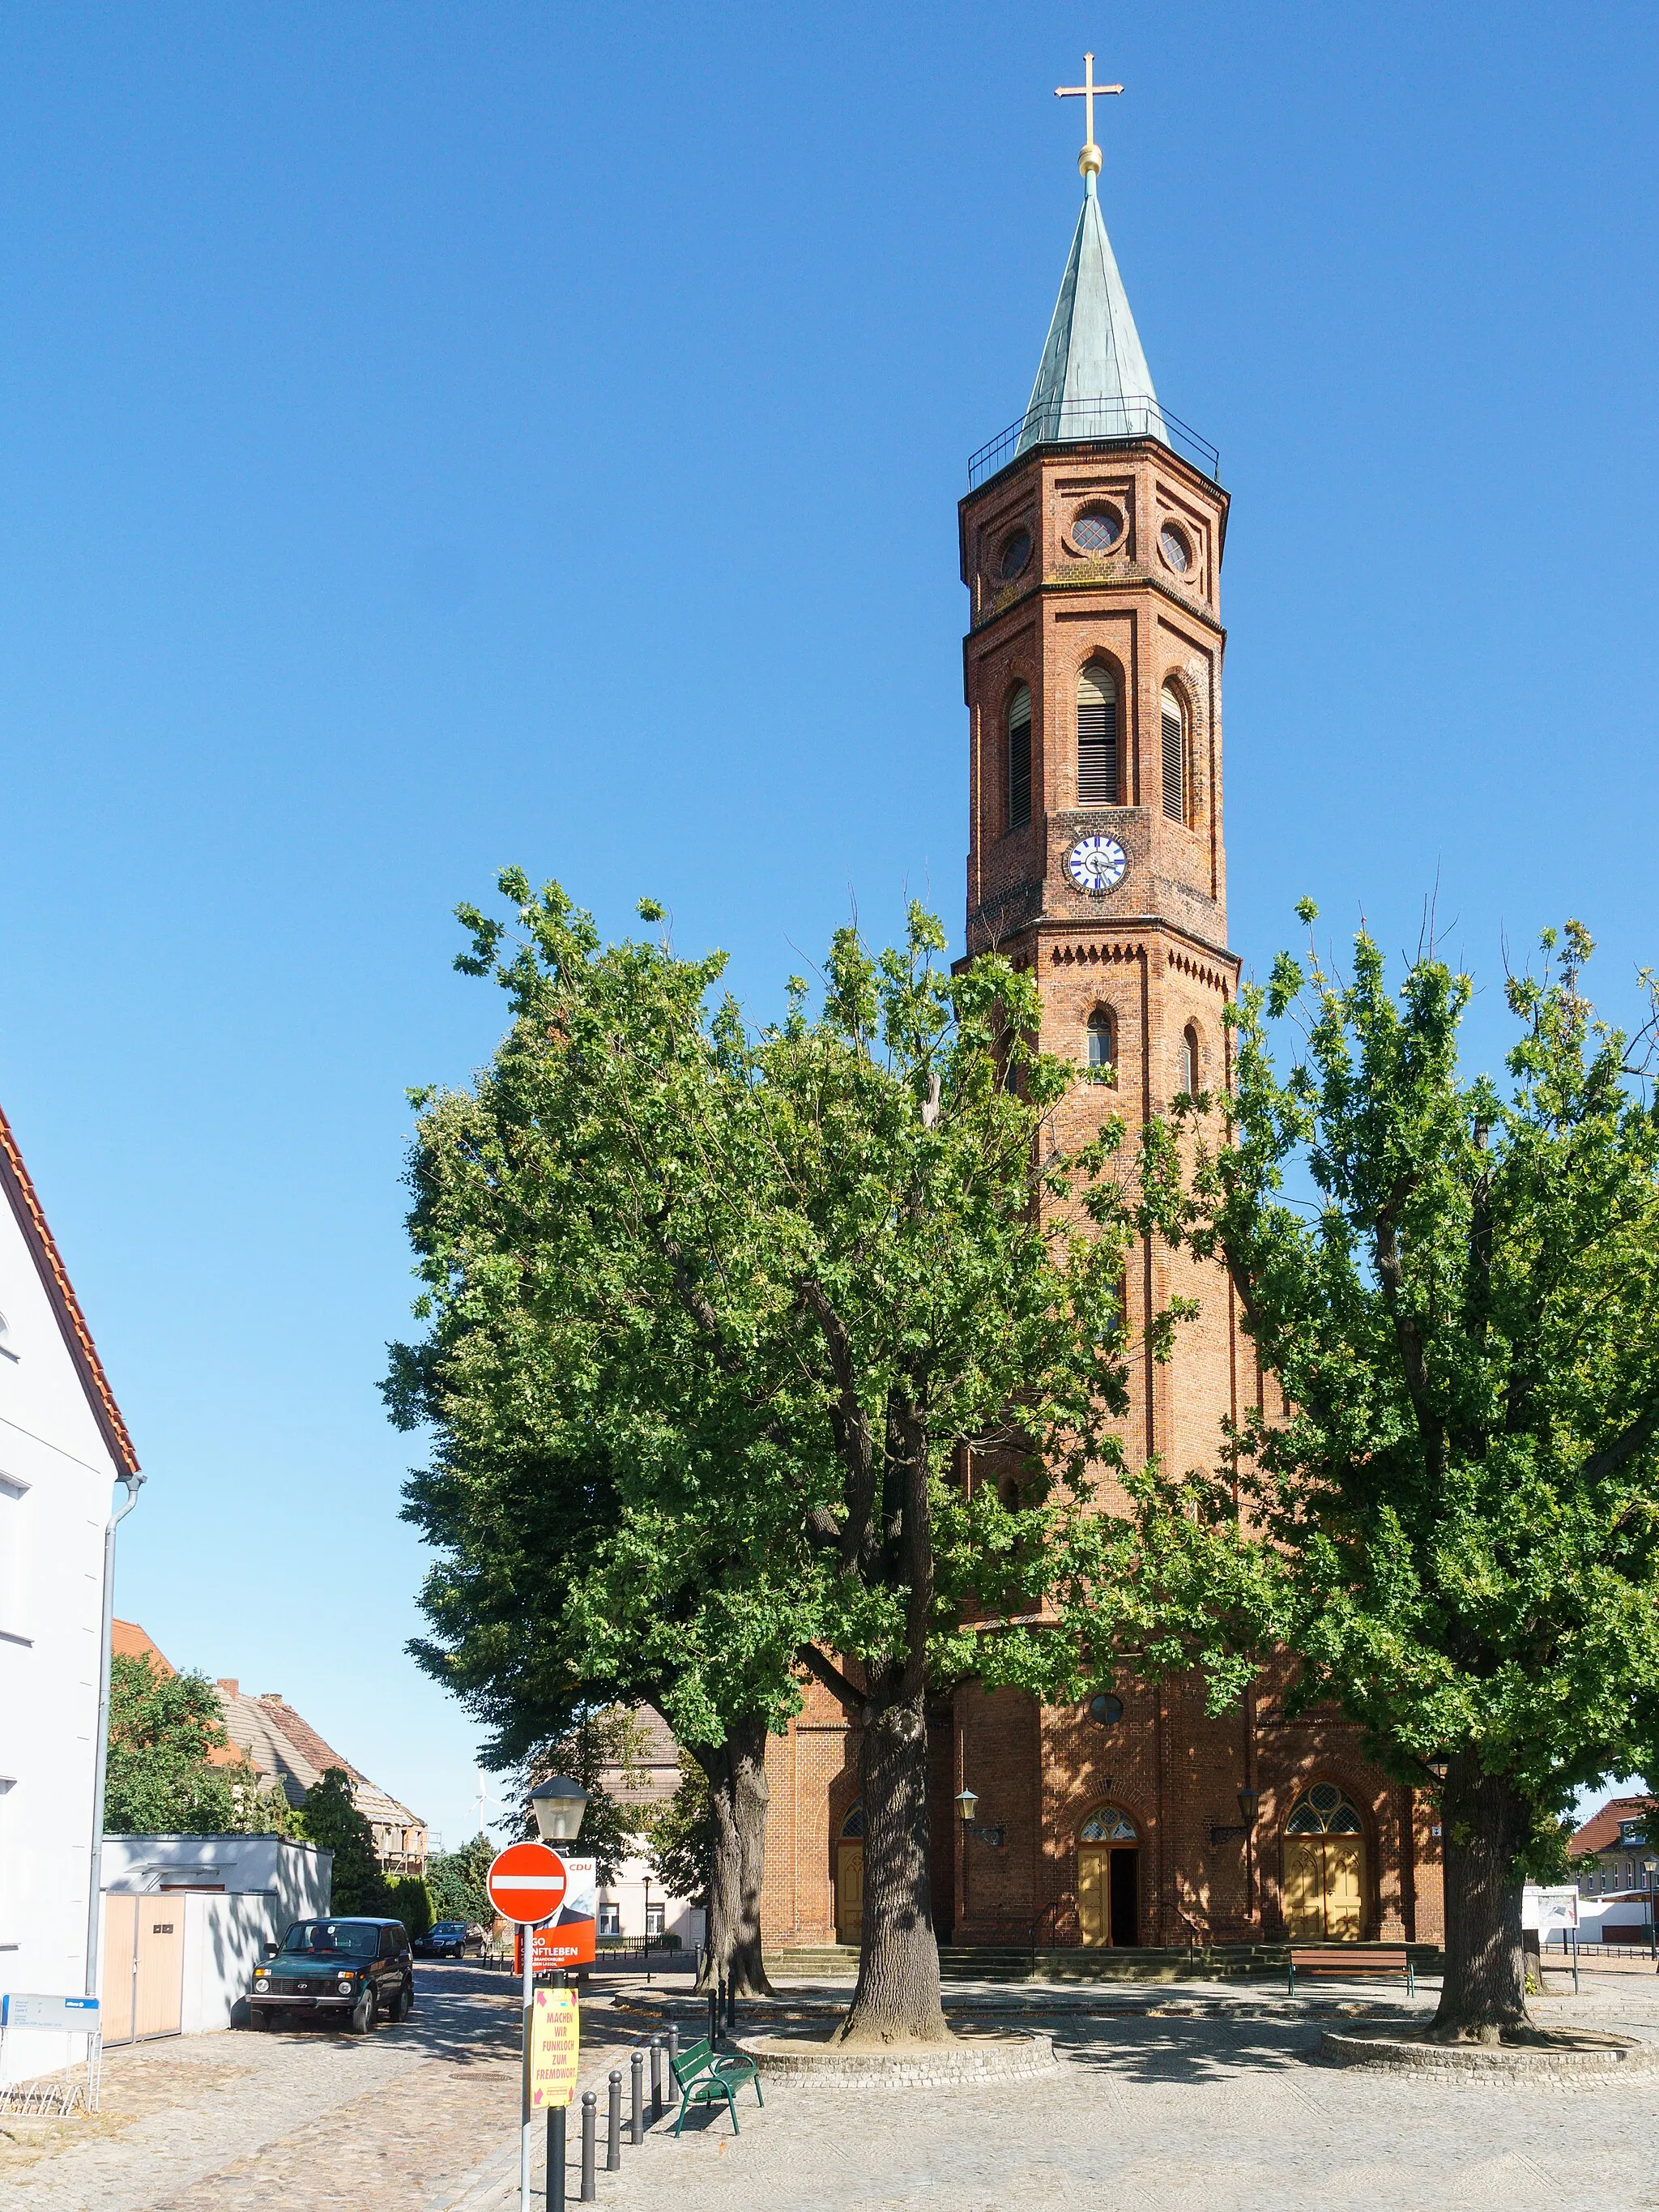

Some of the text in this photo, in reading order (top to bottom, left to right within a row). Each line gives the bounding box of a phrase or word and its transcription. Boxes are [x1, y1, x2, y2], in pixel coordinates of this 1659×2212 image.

[520, 1937, 546, 1946] IGO
[520, 1946, 578, 1957] SNFTLEBEN
[547, 2012, 574, 2023] MACHEN
[554, 2026, 567, 2037] WIR
[542, 2040, 574, 2052] FUNKLOCH
[552, 2054, 567, 2065] ZUM
[536, 2067, 577, 2080] FREMDWORT.
